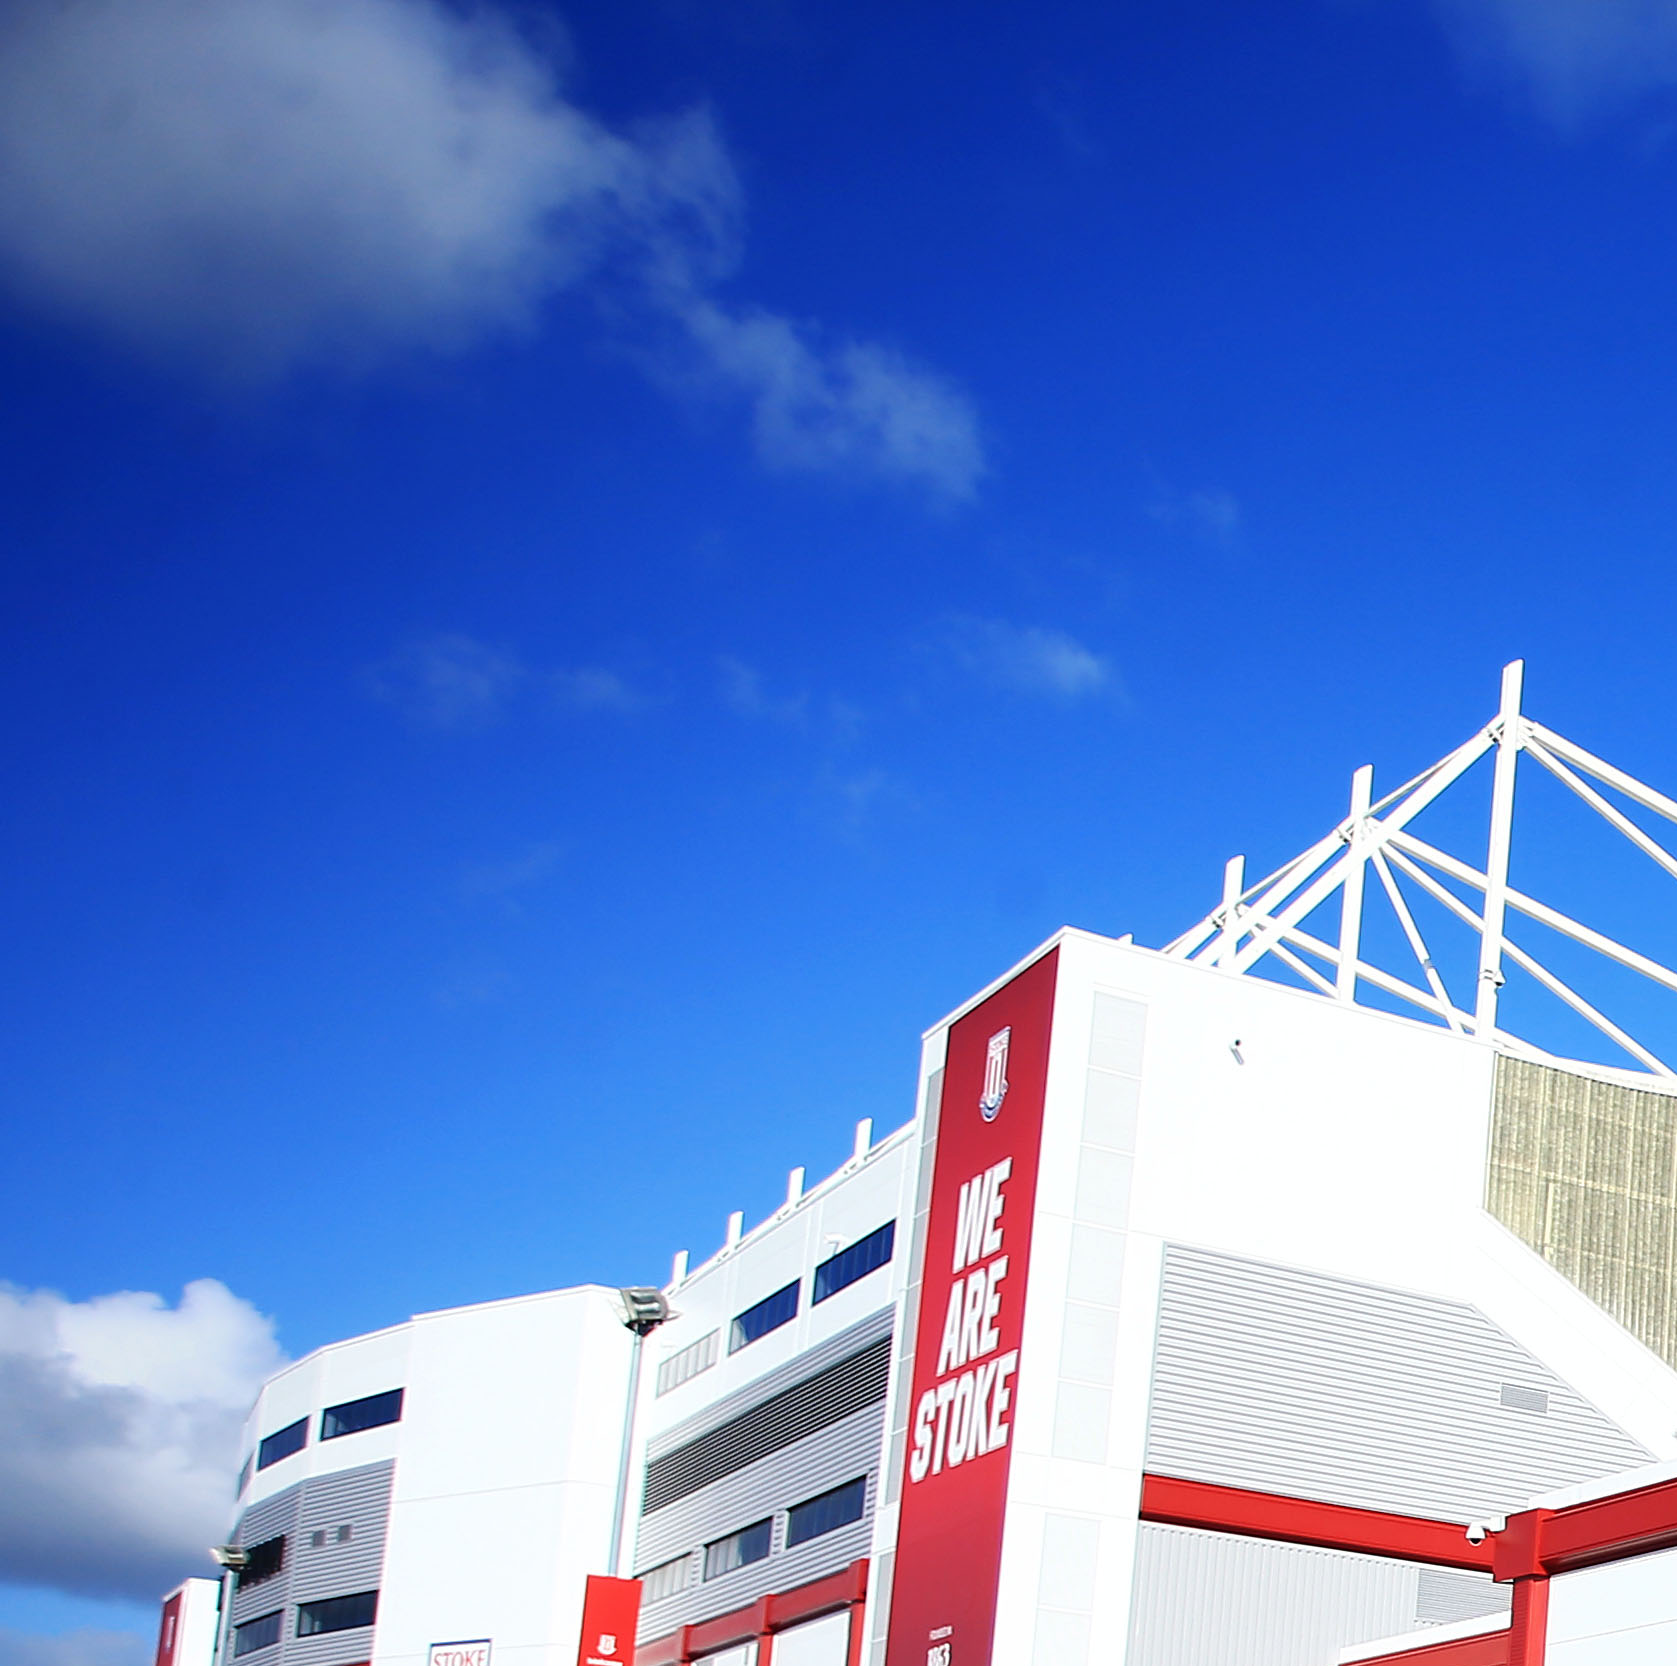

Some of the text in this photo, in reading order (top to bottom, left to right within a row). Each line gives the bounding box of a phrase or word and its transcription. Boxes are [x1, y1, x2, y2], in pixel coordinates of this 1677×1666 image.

[952, 1156, 1003, 1274] WE
[936, 1255, 1009, 1377] ARE
[909, 1349, 1018, 1484] STOKE
